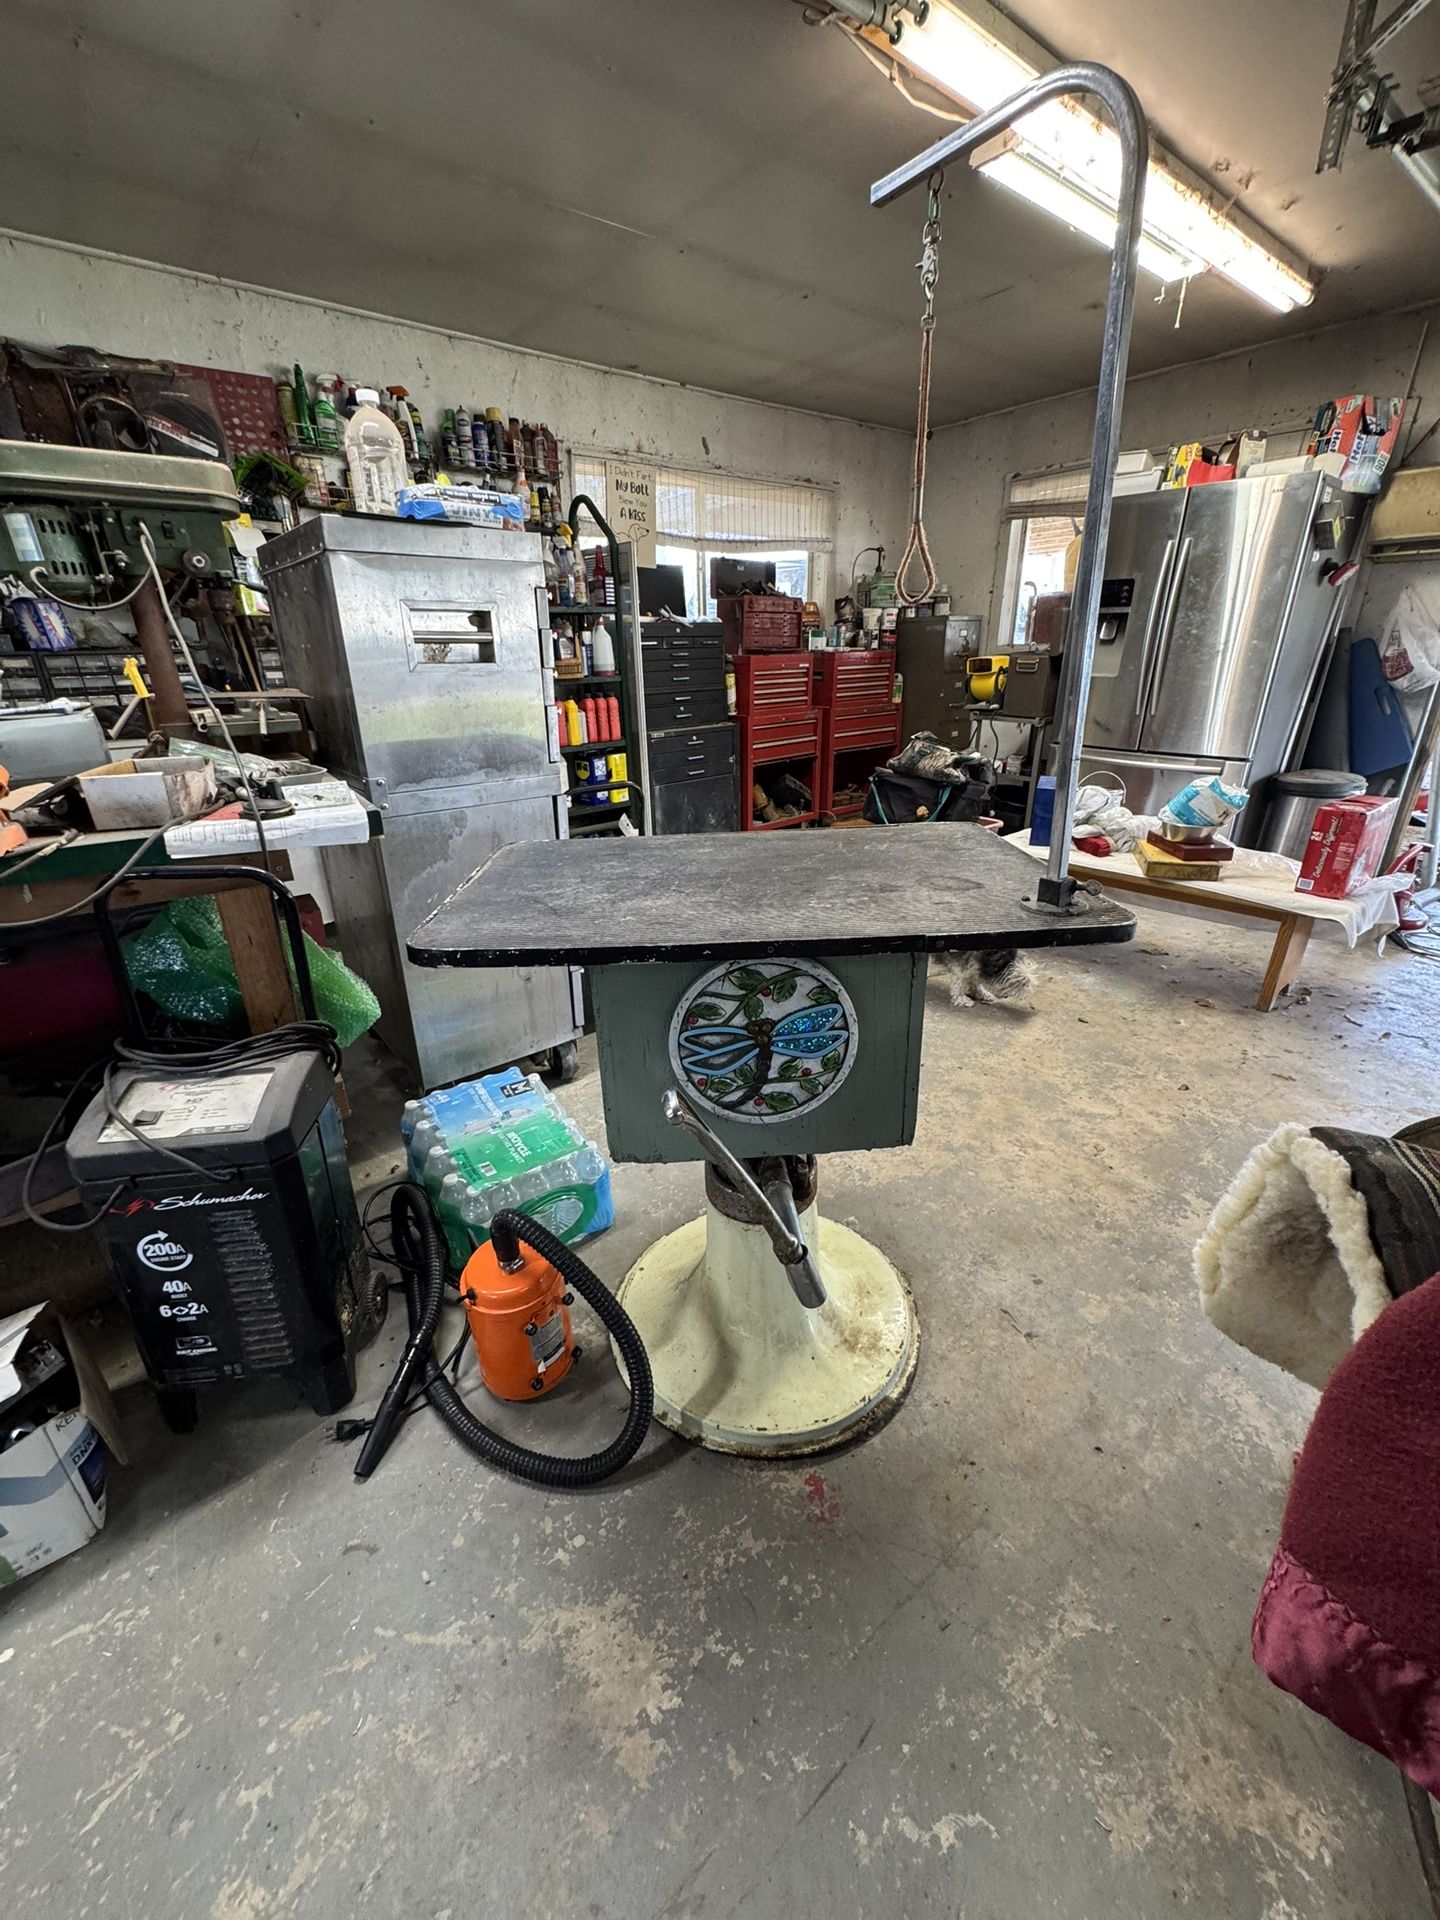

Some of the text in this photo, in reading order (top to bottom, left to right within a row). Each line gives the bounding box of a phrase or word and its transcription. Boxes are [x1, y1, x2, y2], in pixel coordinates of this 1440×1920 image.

[636, 470, 652, 482] Fart
[635, 497, 648, 508] You
[620, 507, 627, 519] A
[153, 1187, 270, 1211] Schumacher
[144, 1242, 186, 1257] 200A
[162, 1280, 193, 1293] 40A
